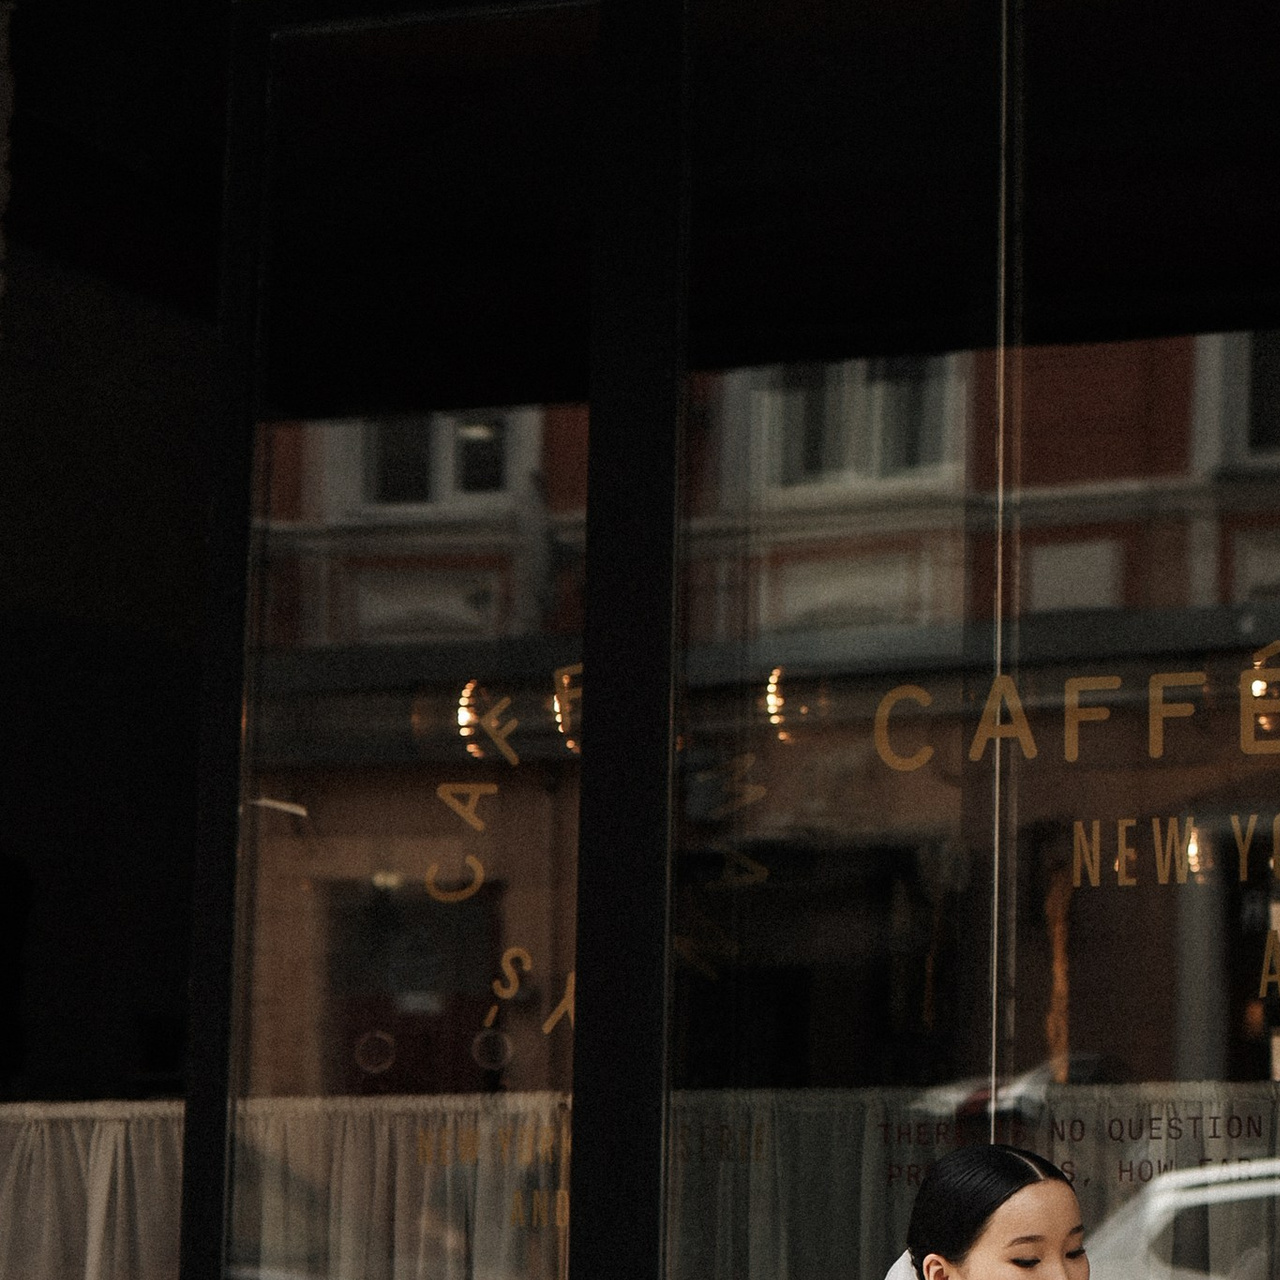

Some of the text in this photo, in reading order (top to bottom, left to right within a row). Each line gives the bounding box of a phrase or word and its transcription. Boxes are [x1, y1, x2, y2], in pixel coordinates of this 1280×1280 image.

[1072, 816, 1195, 889] NEW
[1051, 1119, 1085, 1143] NO
[1108, 1115, 1263, 1143] QUESTION
[1118, 1159, 1175, 1183] HOW
